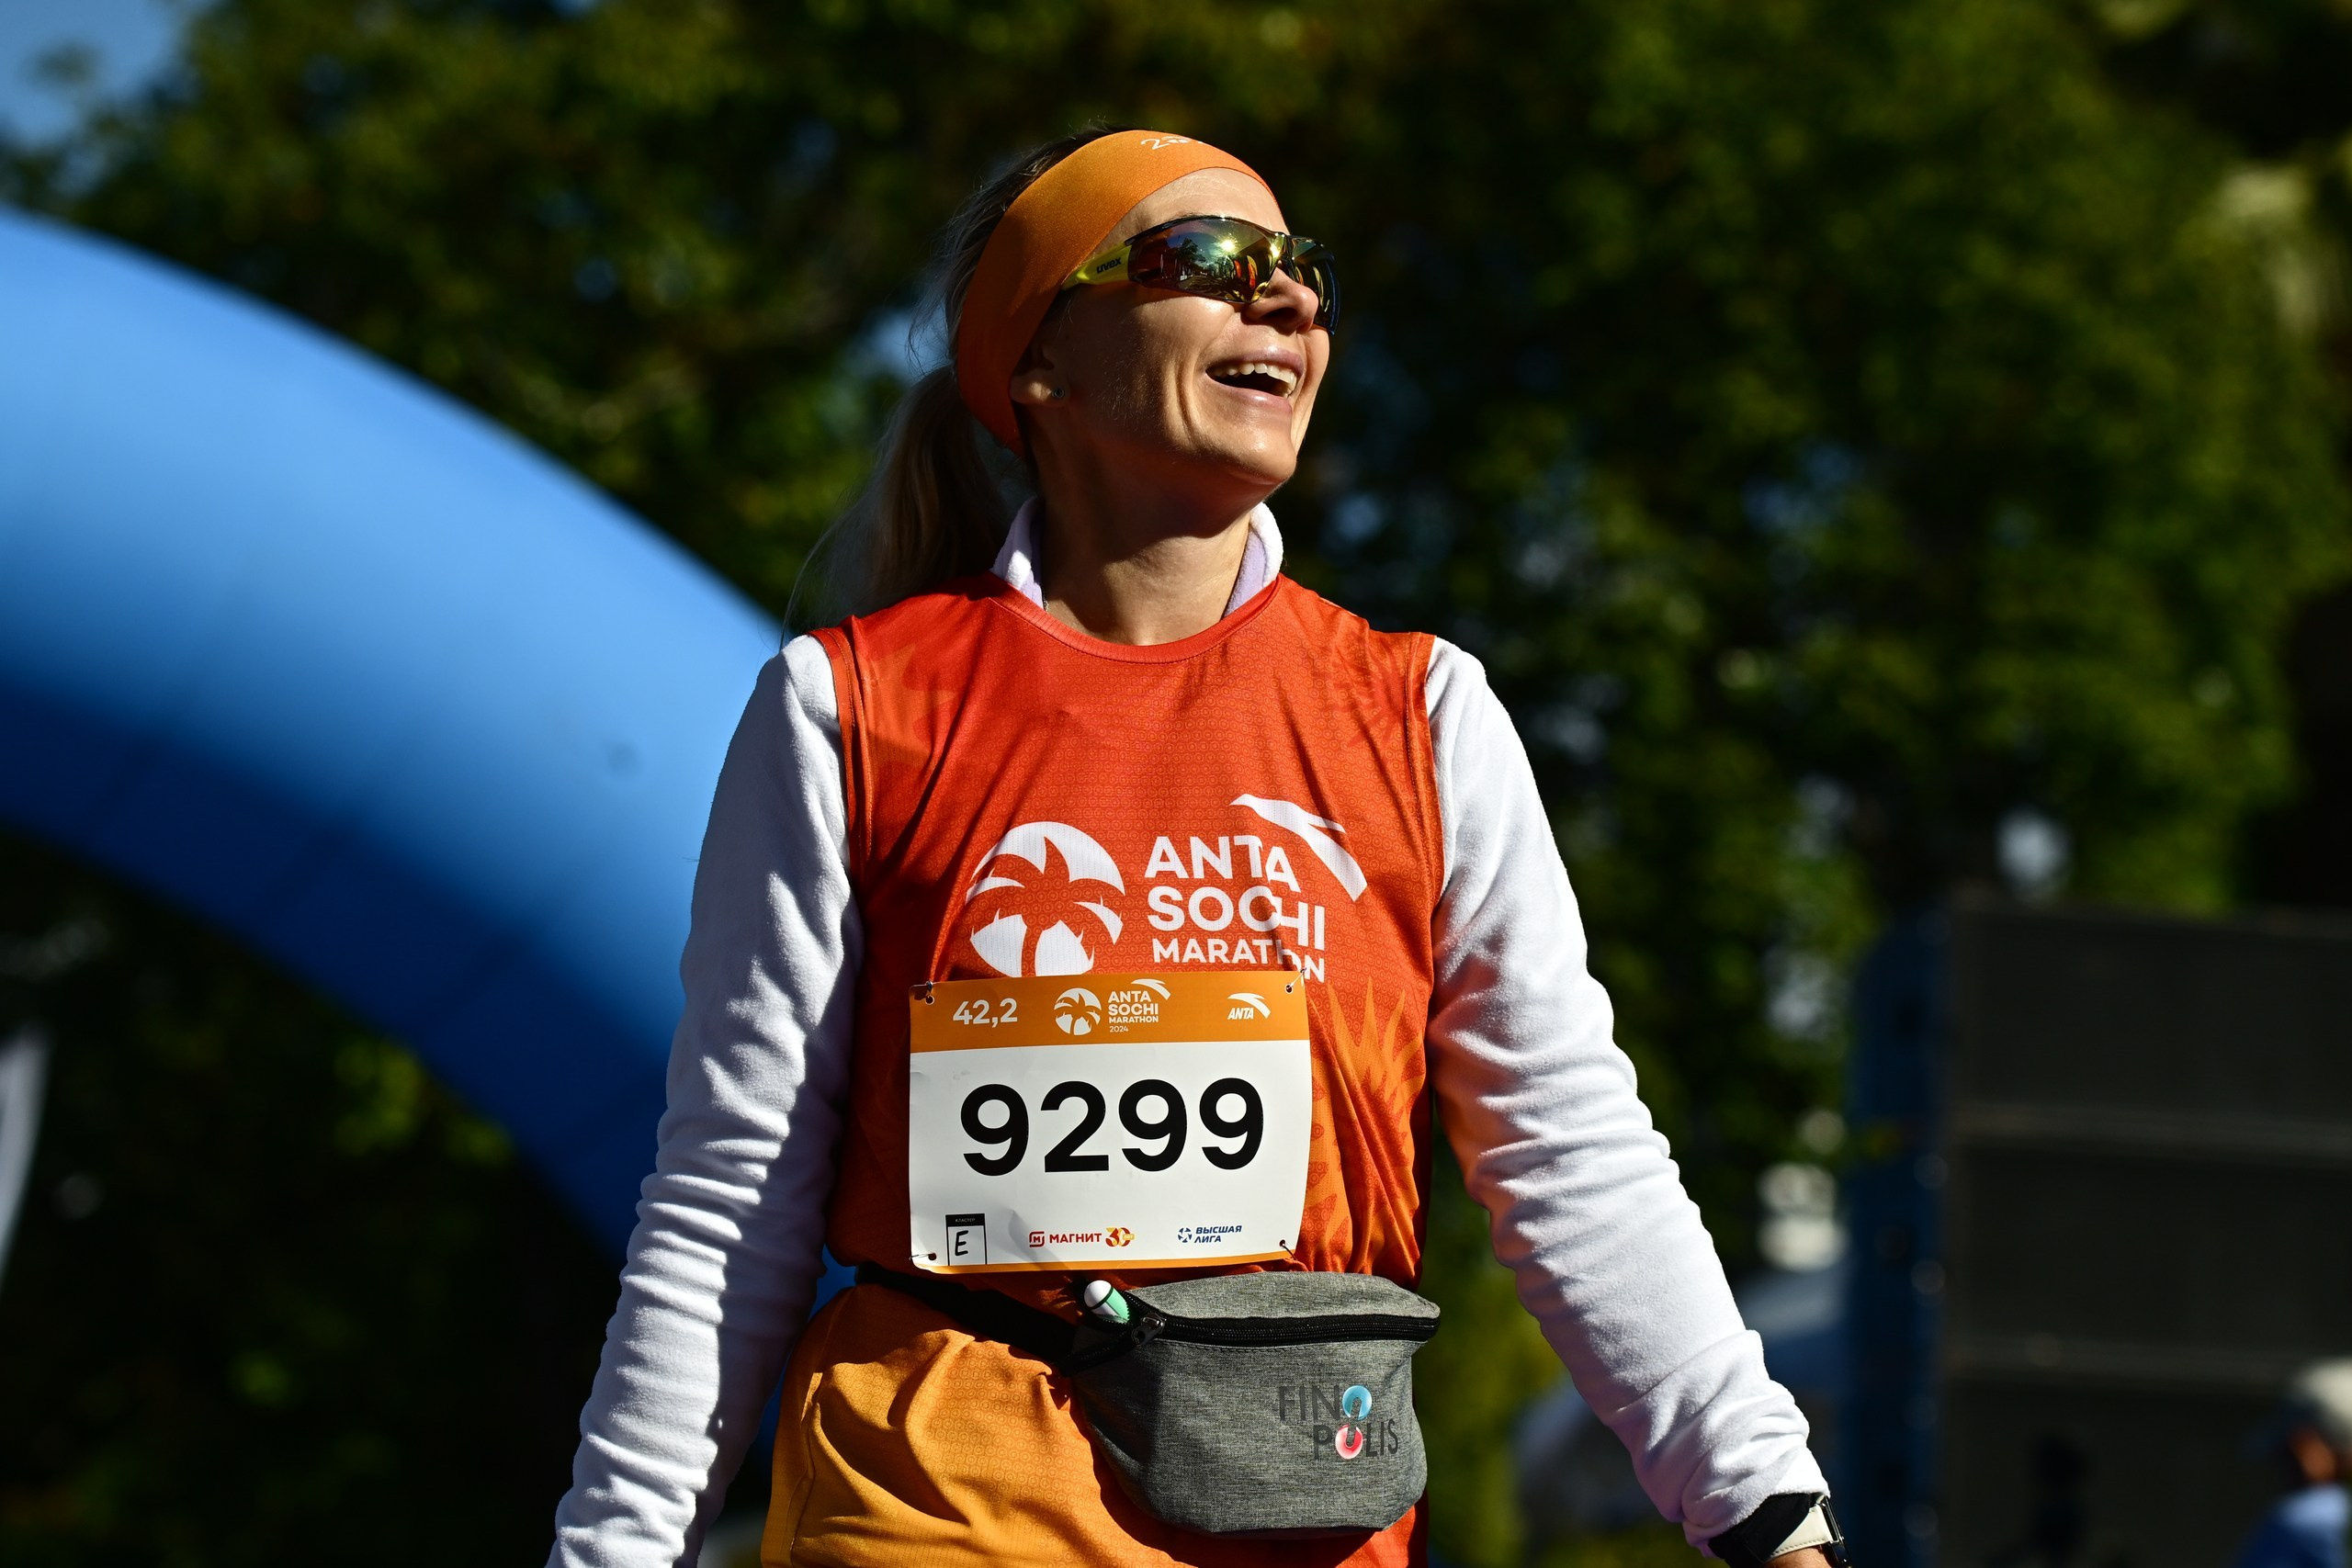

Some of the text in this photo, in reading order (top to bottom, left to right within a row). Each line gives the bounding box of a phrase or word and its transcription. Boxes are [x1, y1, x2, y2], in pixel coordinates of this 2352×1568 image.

[1096, 257, 1122, 274] uvex
[1144, 834, 1301, 893] ANTA
[1147, 885, 1326, 952] SOCHI
[1108, 991, 1151, 1003] ANTA
[953, 998, 1018, 1028] 42,2
[1108, 1003, 1159, 1016] SOCHI
[1227, 1008, 1254, 1021] ANTA
[1108, 1015, 1159, 1024] MARATHON
[1109, 1025, 1129, 1033] 2024
[960, 1077, 1264, 1177] 9299
[1195, 1224, 1242, 1235] ВЫСШАЯ
[1049, 1233, 1102, 1244] МАГНИТ
[1193, 1235, 1222, 1244] ЛИГА
